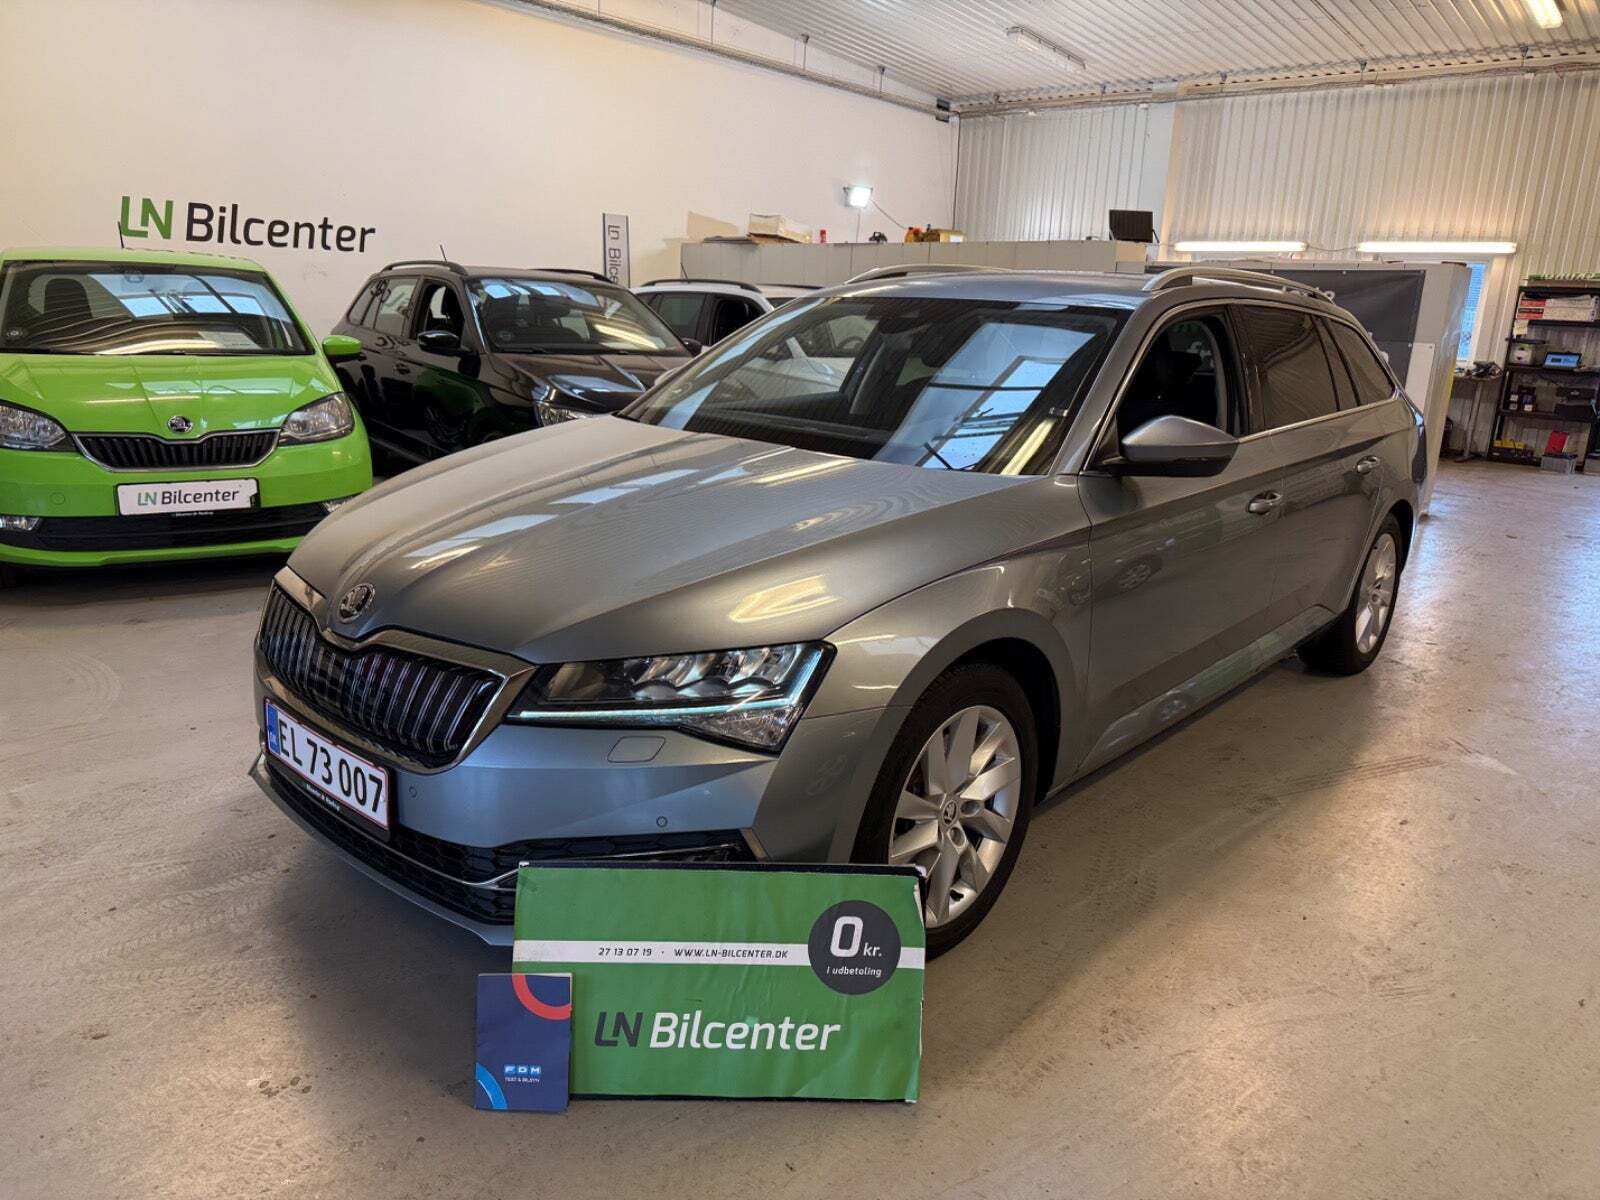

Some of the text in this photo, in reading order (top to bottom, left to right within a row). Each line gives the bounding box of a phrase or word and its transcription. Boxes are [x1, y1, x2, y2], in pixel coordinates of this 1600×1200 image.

[120, 195, 376, 253] LN Bilcenter
[137, 489, 240, 507] LN Bilcenter
[279, 718, 303, 767] EL
[306, 737, 334, 785] 73
[338, 757, 383, 813] 007
[598, 947, 789, 959] 27 13 07 19 WWW.LN-BILCENTER.DK
[830, 915, 883, 958] 0 kr.
[832, 966, 882, 978] udbetaling
[593, 1010, 841, 1051] LN Bilcenter
